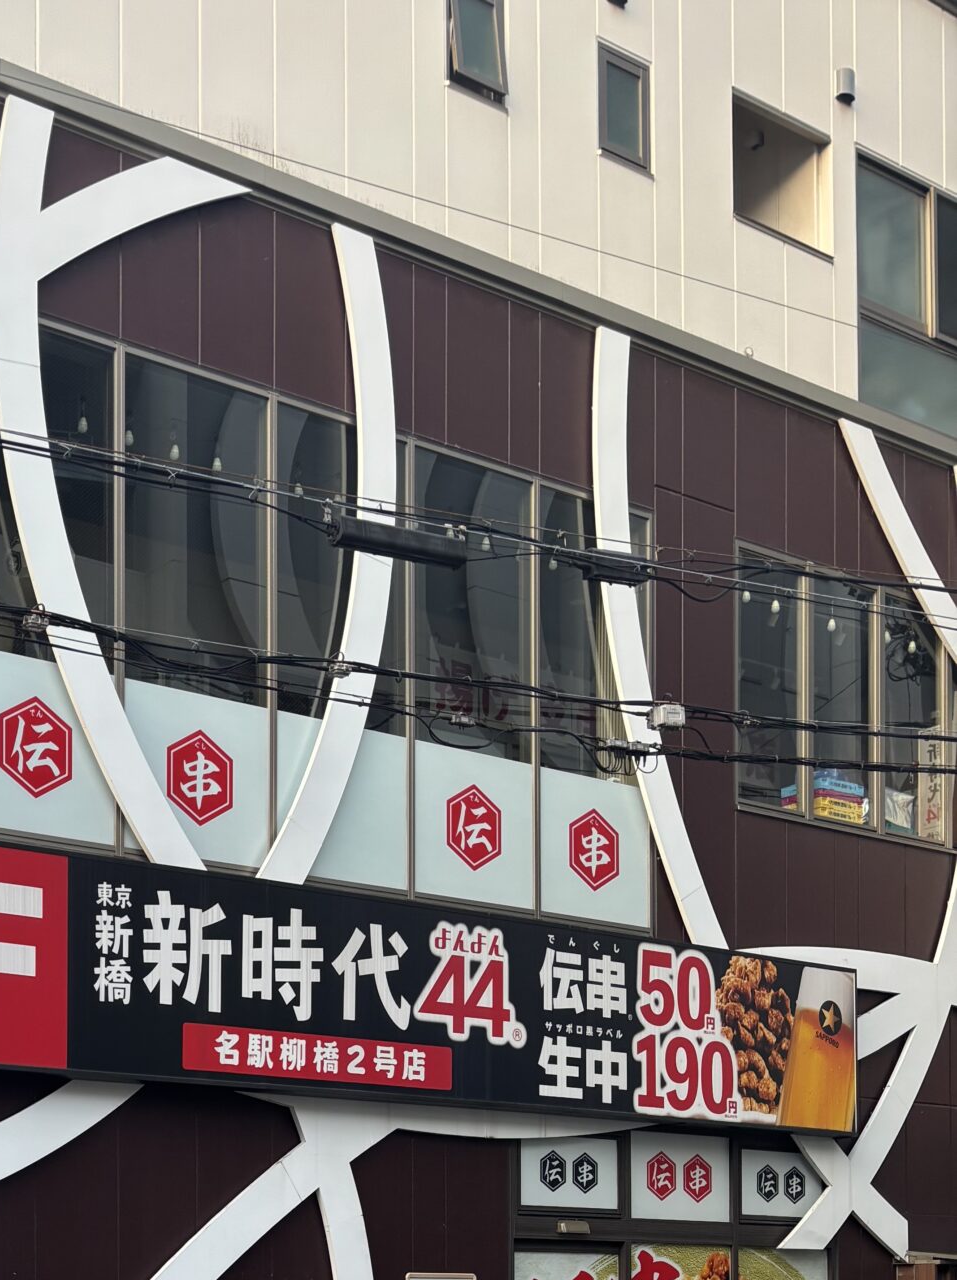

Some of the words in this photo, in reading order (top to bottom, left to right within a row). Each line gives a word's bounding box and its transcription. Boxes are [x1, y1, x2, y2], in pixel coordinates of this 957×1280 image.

[11, 715, 60, 777] 伝
[180, 751, 222, 810] 串
[456, 800, 492, 853] 伝
[579, 827, 611, 878] 串
[96, 882, 133, 908] 東京
[93, 910, 133, 1005] 新橋
[143, 890, 411, 1031] 新時代
[435, 928, 504, 957] よんよん
[548, 934, 620, 953] でんぐし
[539, 948, 627, 1018] 伝串
[214, 1031, 426, 1081] 名駅柳橋2号店
[545, 1021, 623, 1039] サッポロ黒ラベル
[538, 1036, 627, 1104] 生中
